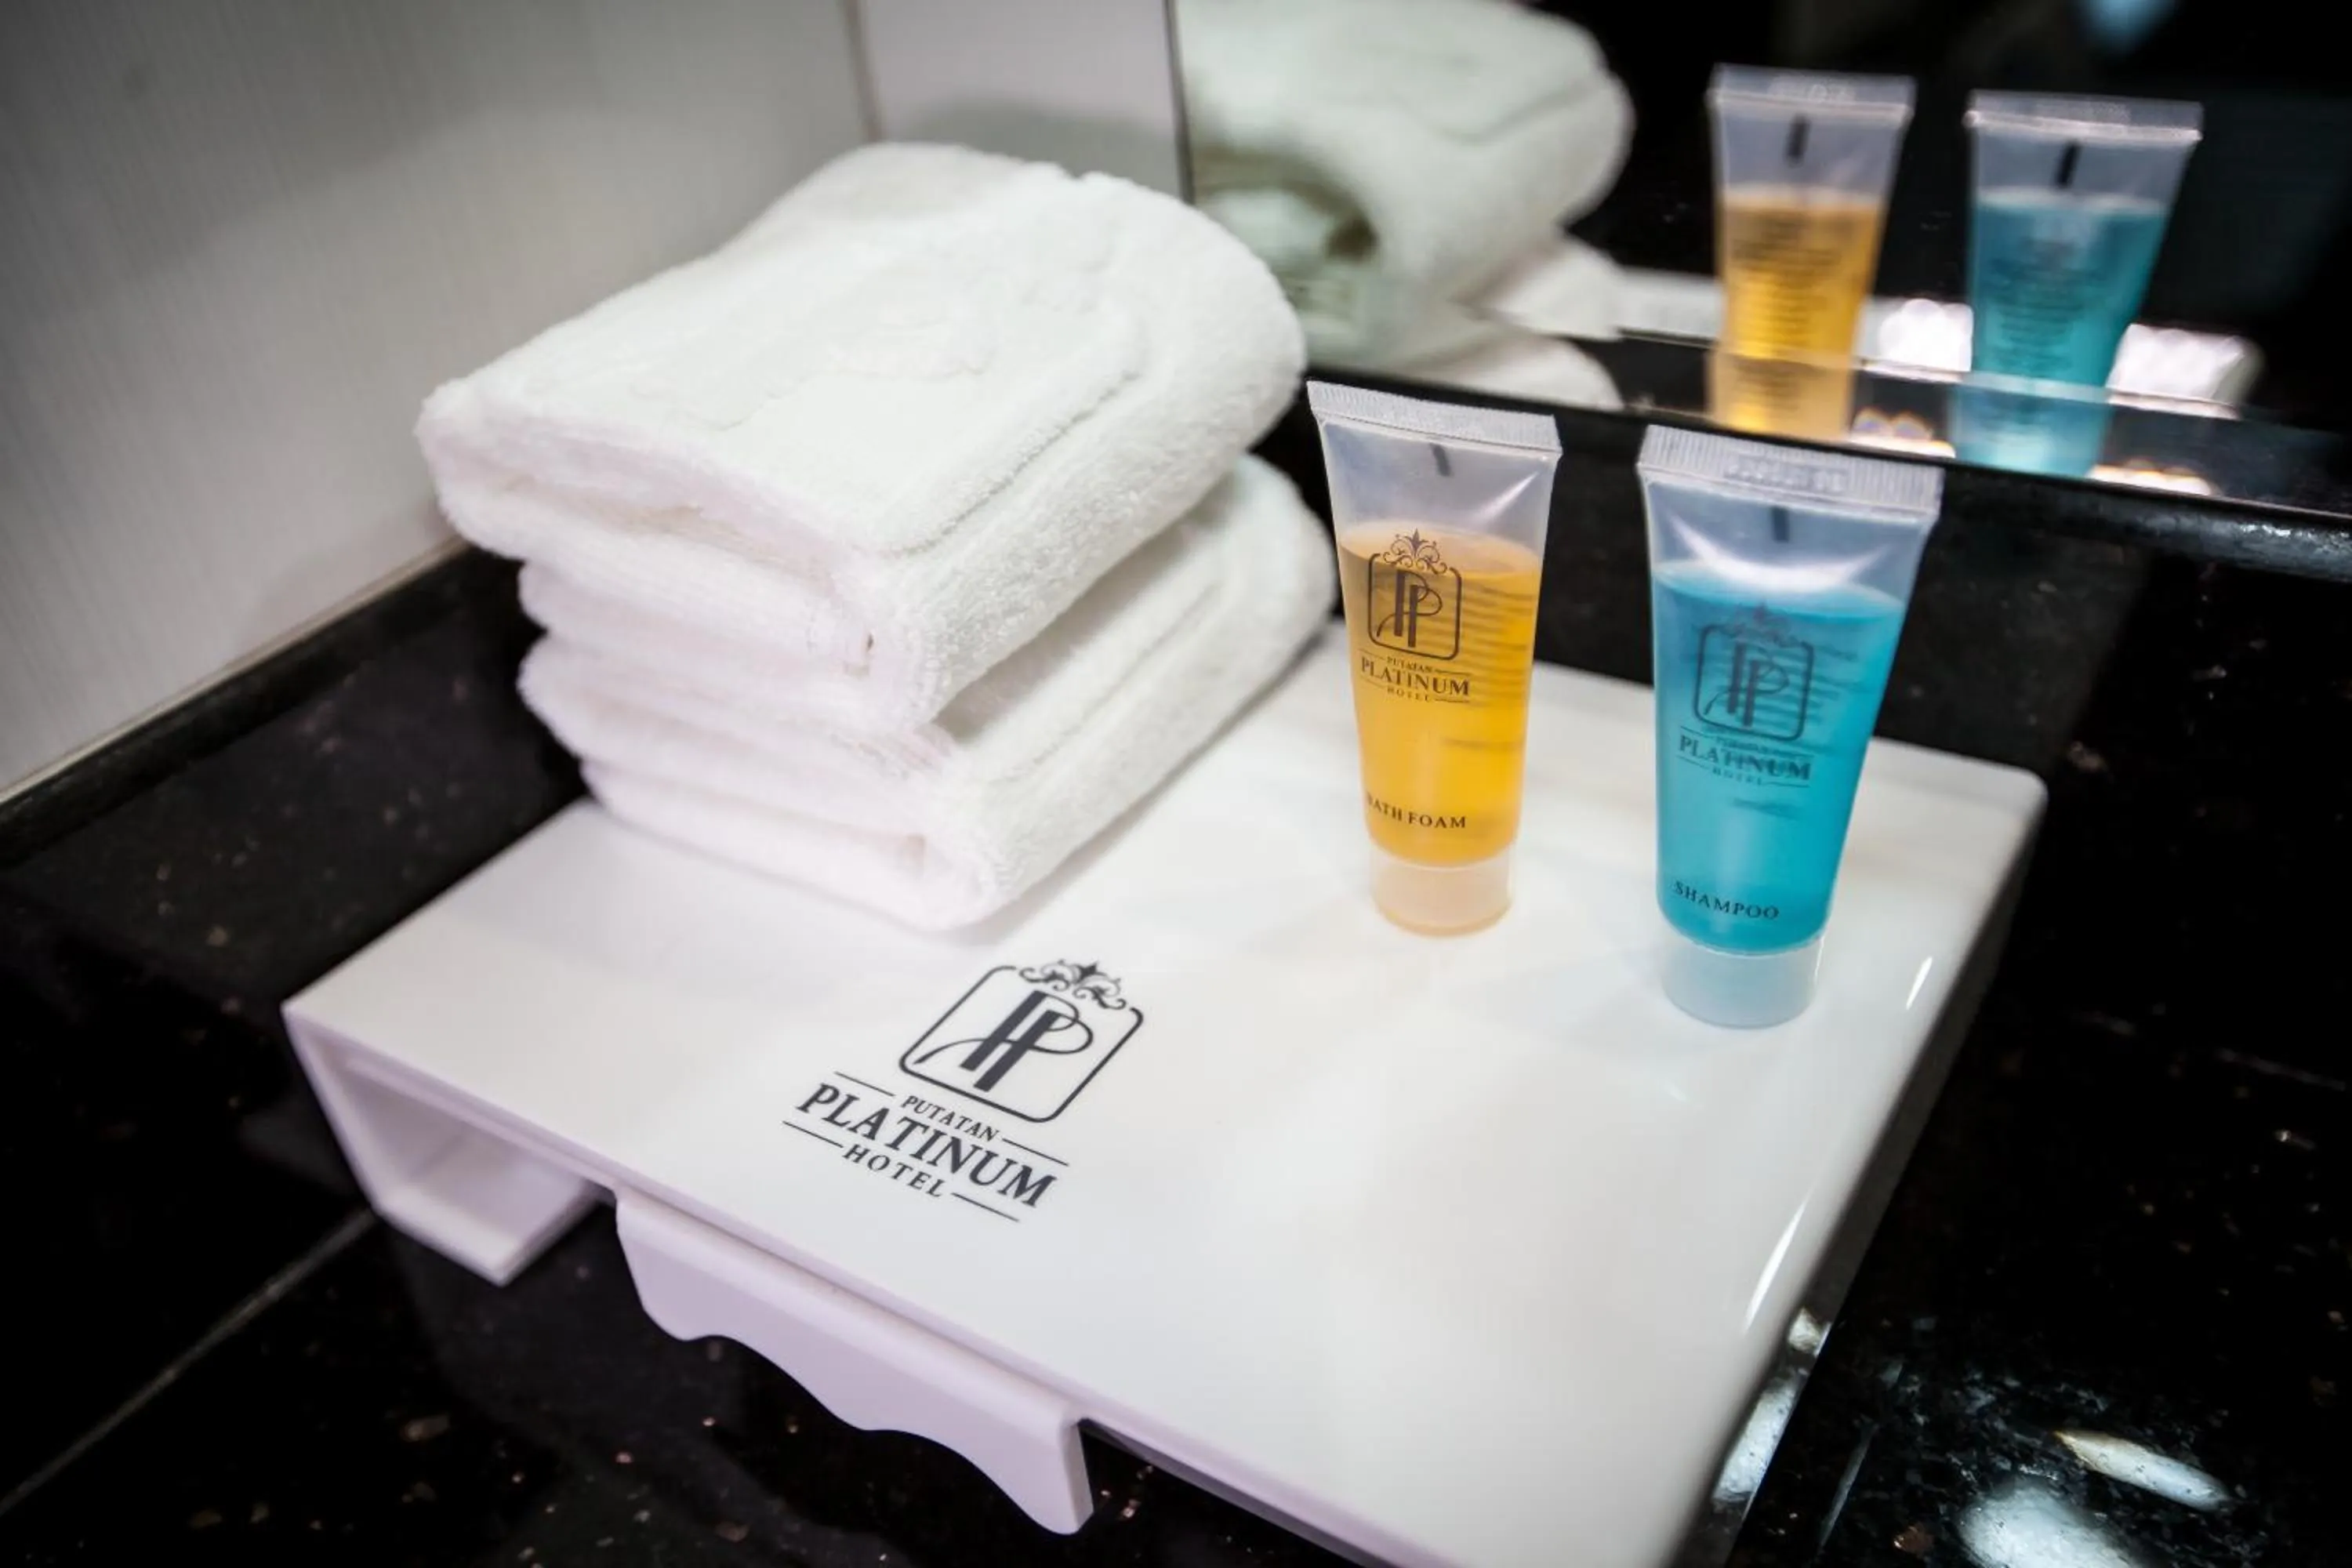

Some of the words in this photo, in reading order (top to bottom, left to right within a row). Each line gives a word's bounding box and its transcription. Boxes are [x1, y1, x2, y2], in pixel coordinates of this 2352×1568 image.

[1362, 656, 1469, 696] PLATINUM
[1679, 735, 1811, 781] PLATINUM
[1408, 811, 1466, 829] FOAM
[1675, 880, 1780, 920] SHAMPOO
[901, 1094, 1000, 1142] PUTATAN
[795, 1083, 1058, 1207] PLATINUM
[842, 1143, 943, 1198] HOTEL
